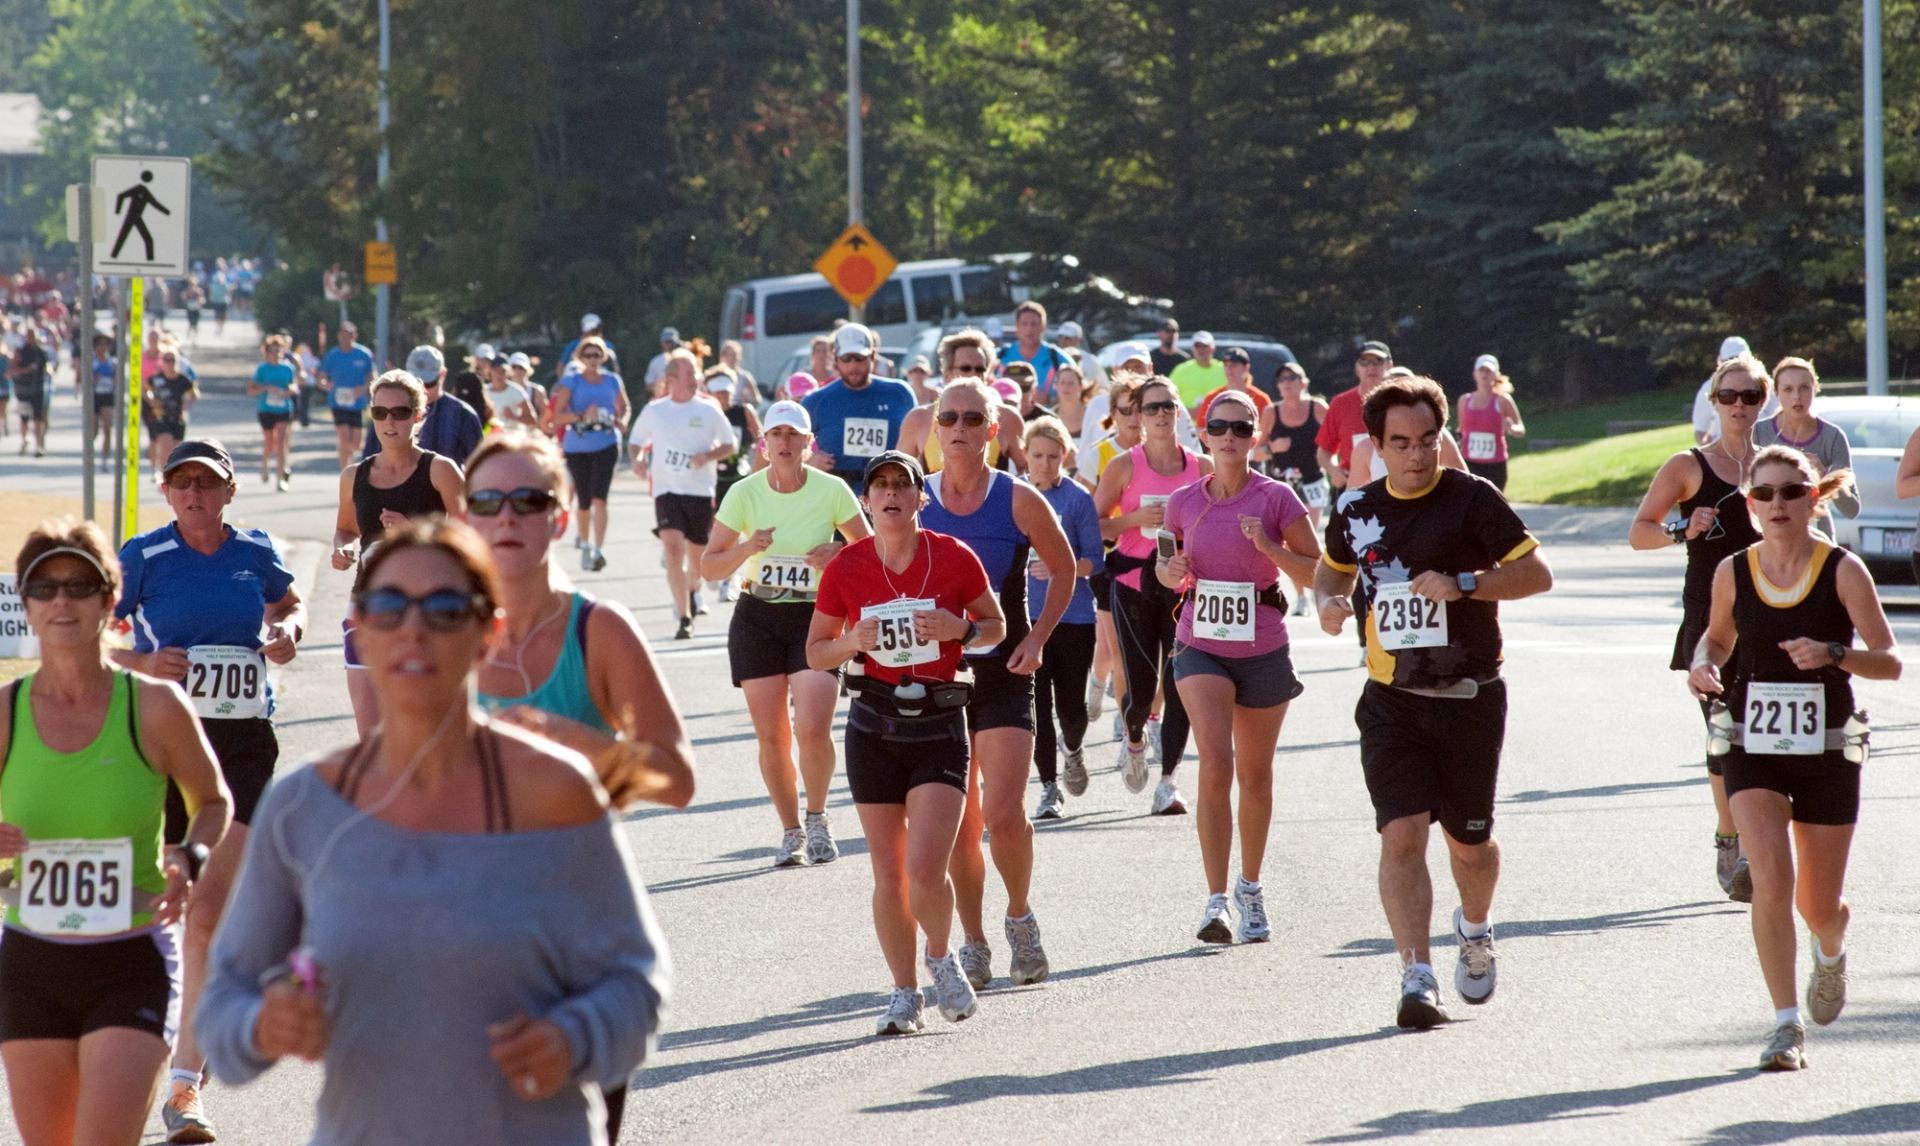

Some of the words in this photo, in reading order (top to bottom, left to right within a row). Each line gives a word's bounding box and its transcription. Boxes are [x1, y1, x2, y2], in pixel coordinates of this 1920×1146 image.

[847, 427, 883, 446] 2246
[761, 565, 810, 587] 2144
[1197, 593, 1249, 626] 2069
[1378, 597, 1439, 632] 2392
[191, 663, 257, 699] 2709
[1750, 700, 1818, 735] 2213
[27, 860, 120, 908] 2065
